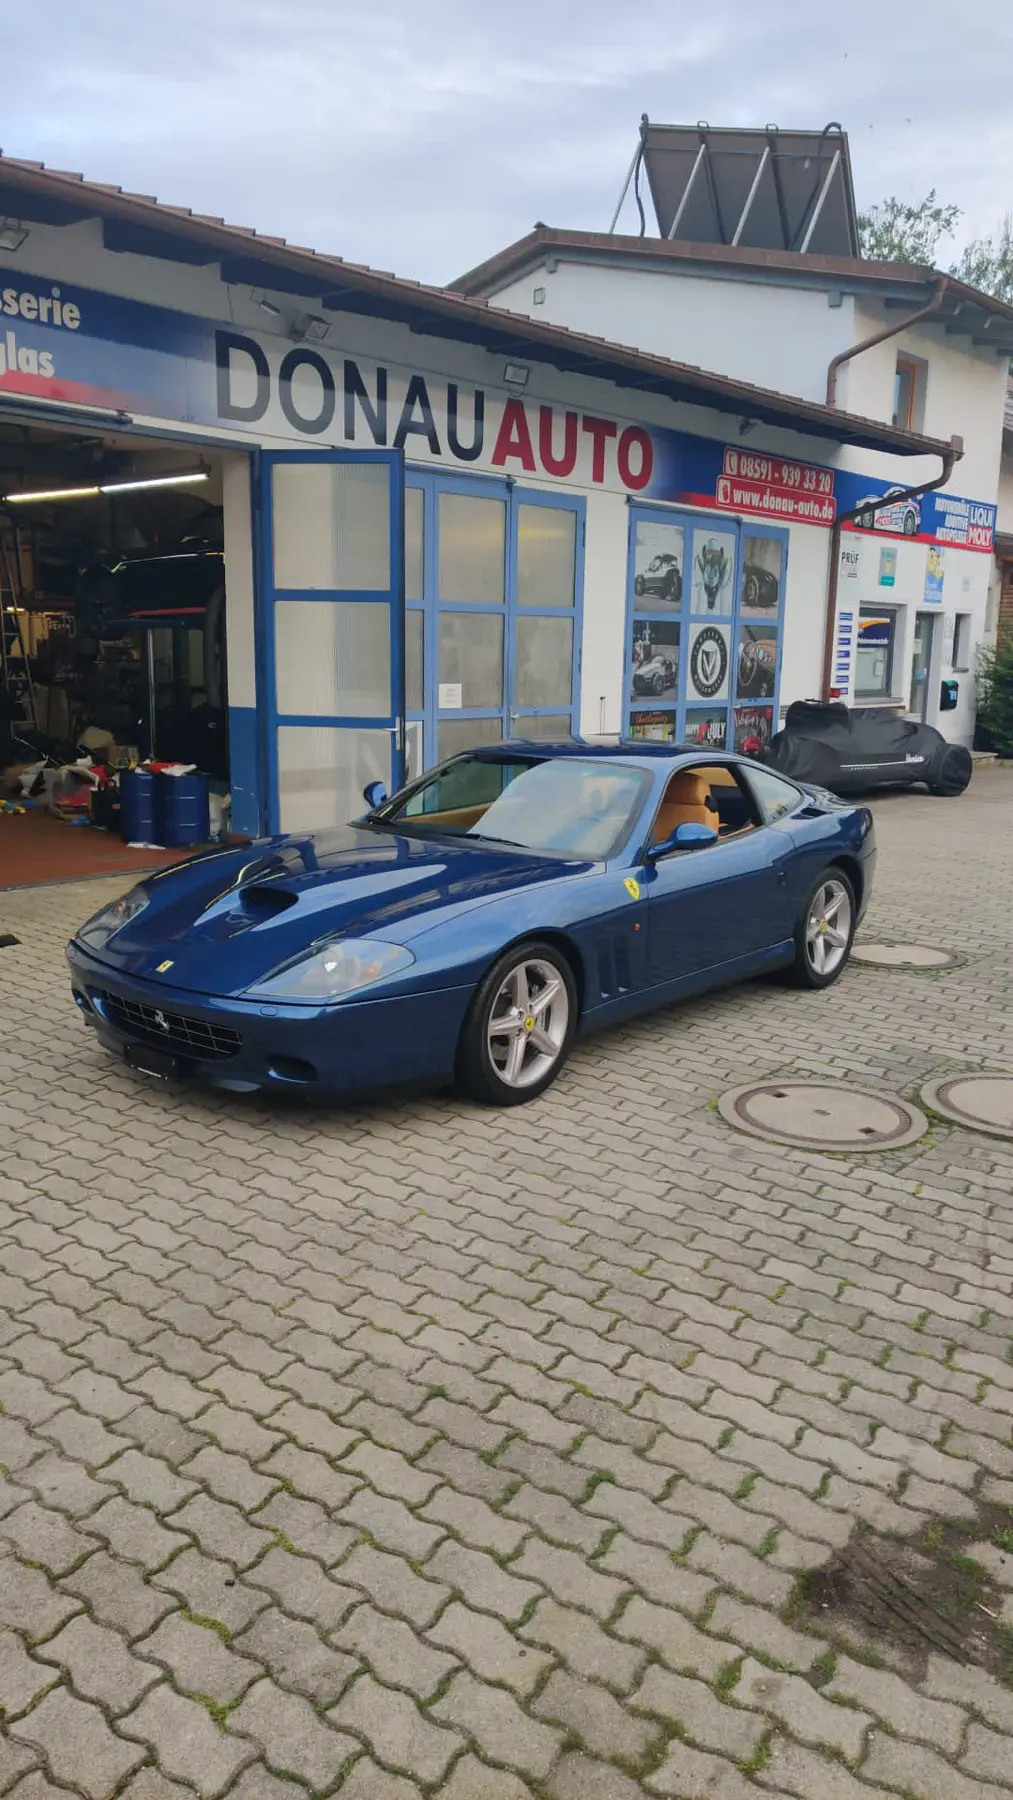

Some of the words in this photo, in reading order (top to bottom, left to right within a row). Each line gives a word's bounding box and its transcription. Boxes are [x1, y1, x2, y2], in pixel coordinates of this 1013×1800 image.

[0, 286, 81, 329] serie
[740, 455, 772, 480] 08591
[782, 464, 801, 487] 939
[803, 469, 816, 490] 33
[818, 472, 831, 493] 20
[733, 487, 833, 519] www.donau-auto.de
[970, 506, 993, 527] LIQUI
[968, 527, 992, 547] MOLY
